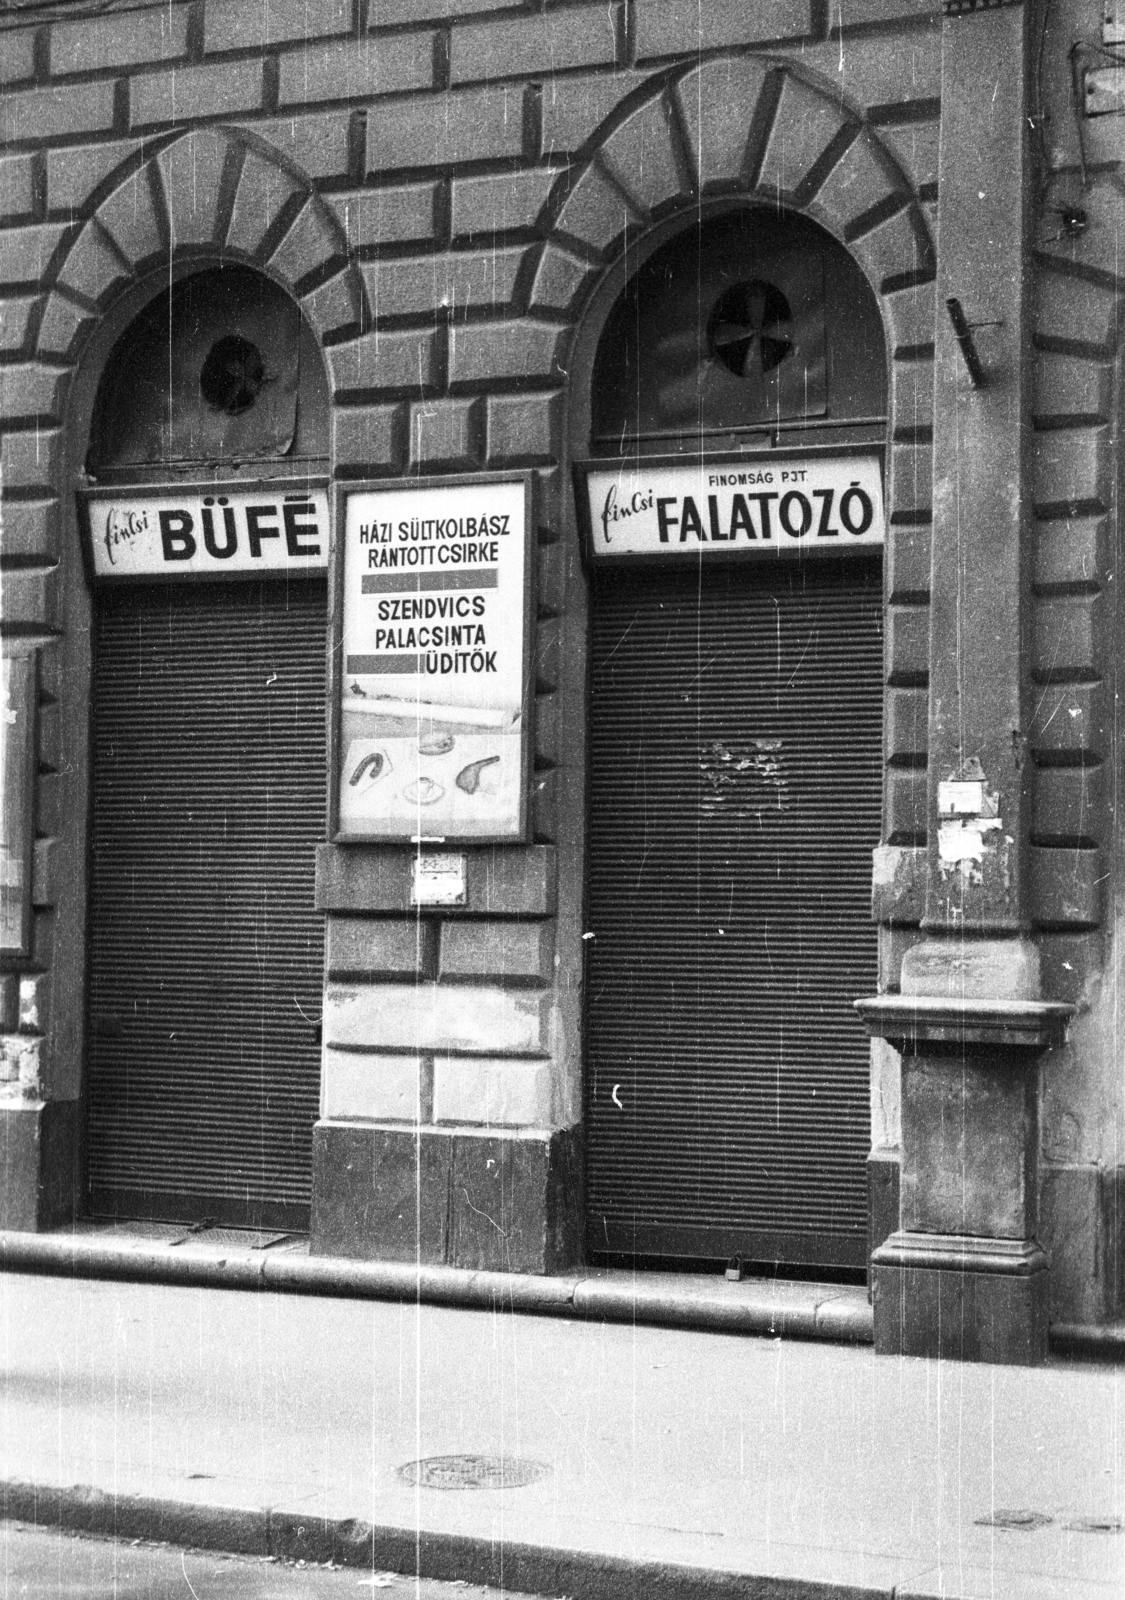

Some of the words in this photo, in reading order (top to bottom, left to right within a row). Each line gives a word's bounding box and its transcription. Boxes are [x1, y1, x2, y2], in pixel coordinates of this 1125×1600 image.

[708, 470, 774, 487] FINOMSÁG
[656, 481, 874, 543] FALATOZÓ
[158, 495, 321, 561] BÜFÉ
[359, 519, 393, 544] HÁZI
[398, 512, 511, 542] SÜLTKOLBÁSZ
[368, 544, 436, 569] RÁNTOTT
[437, 541, 499, 564] CSIRKE
[378, 595, 486, 621] SZENDVICS
[375, 624, 486, 649] PALACSINTA
[426, 647, 498, 674] ÜDÍTŐK
